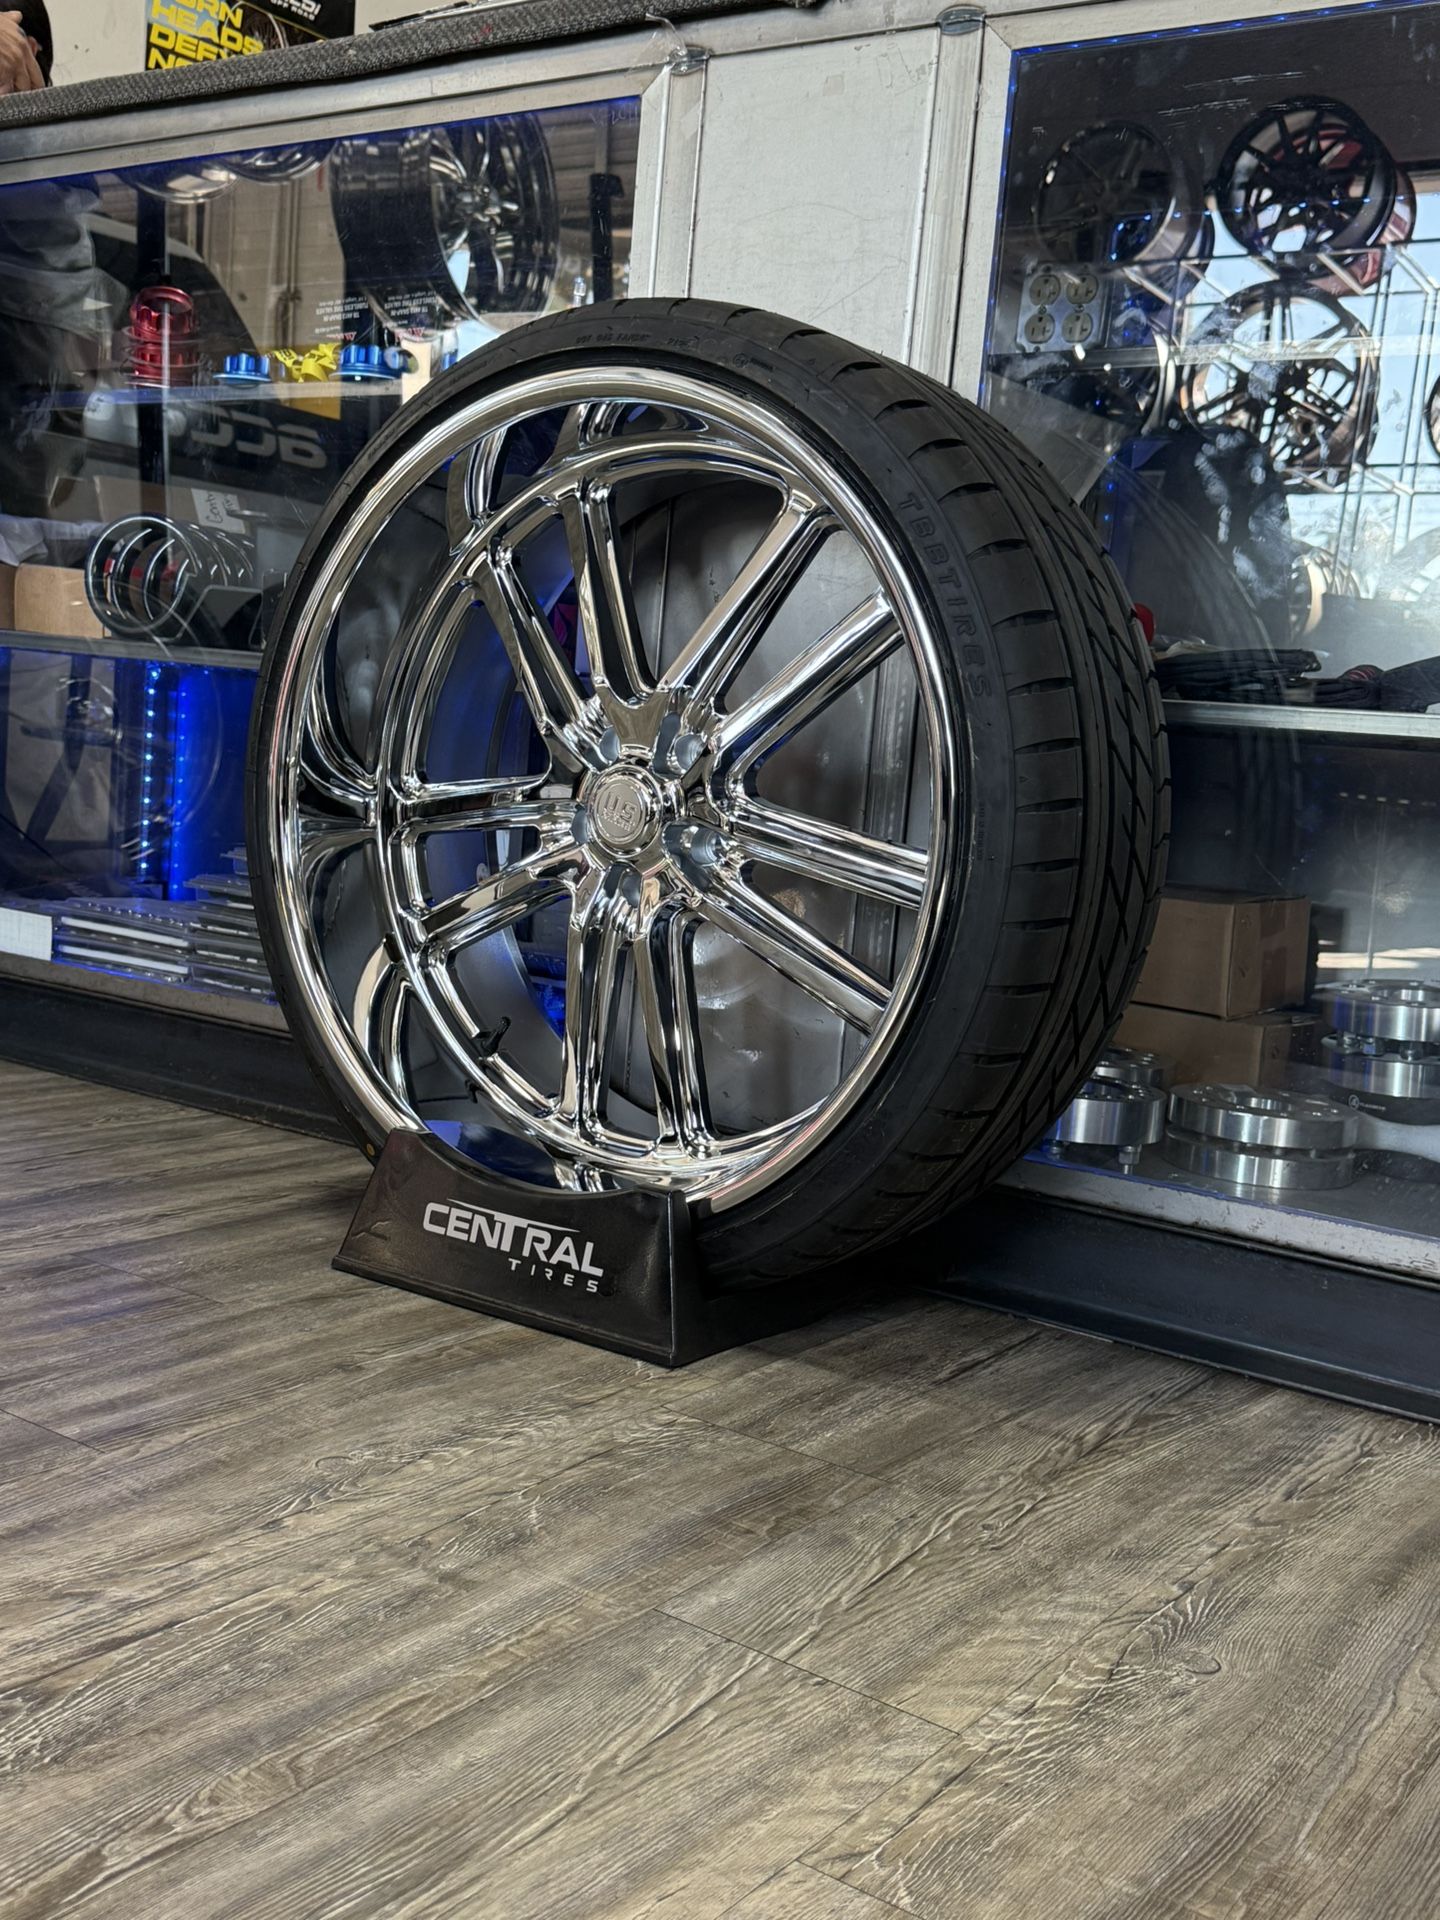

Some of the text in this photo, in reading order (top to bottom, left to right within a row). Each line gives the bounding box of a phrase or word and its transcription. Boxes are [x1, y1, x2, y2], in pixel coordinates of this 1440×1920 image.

[152, 0, 264, 55] HEADS
[290, 5, 316, 21] ROAD
[423, 1198, 604, 1277] CENTRAL
[508, 1257, 599, 1293] TIRES
